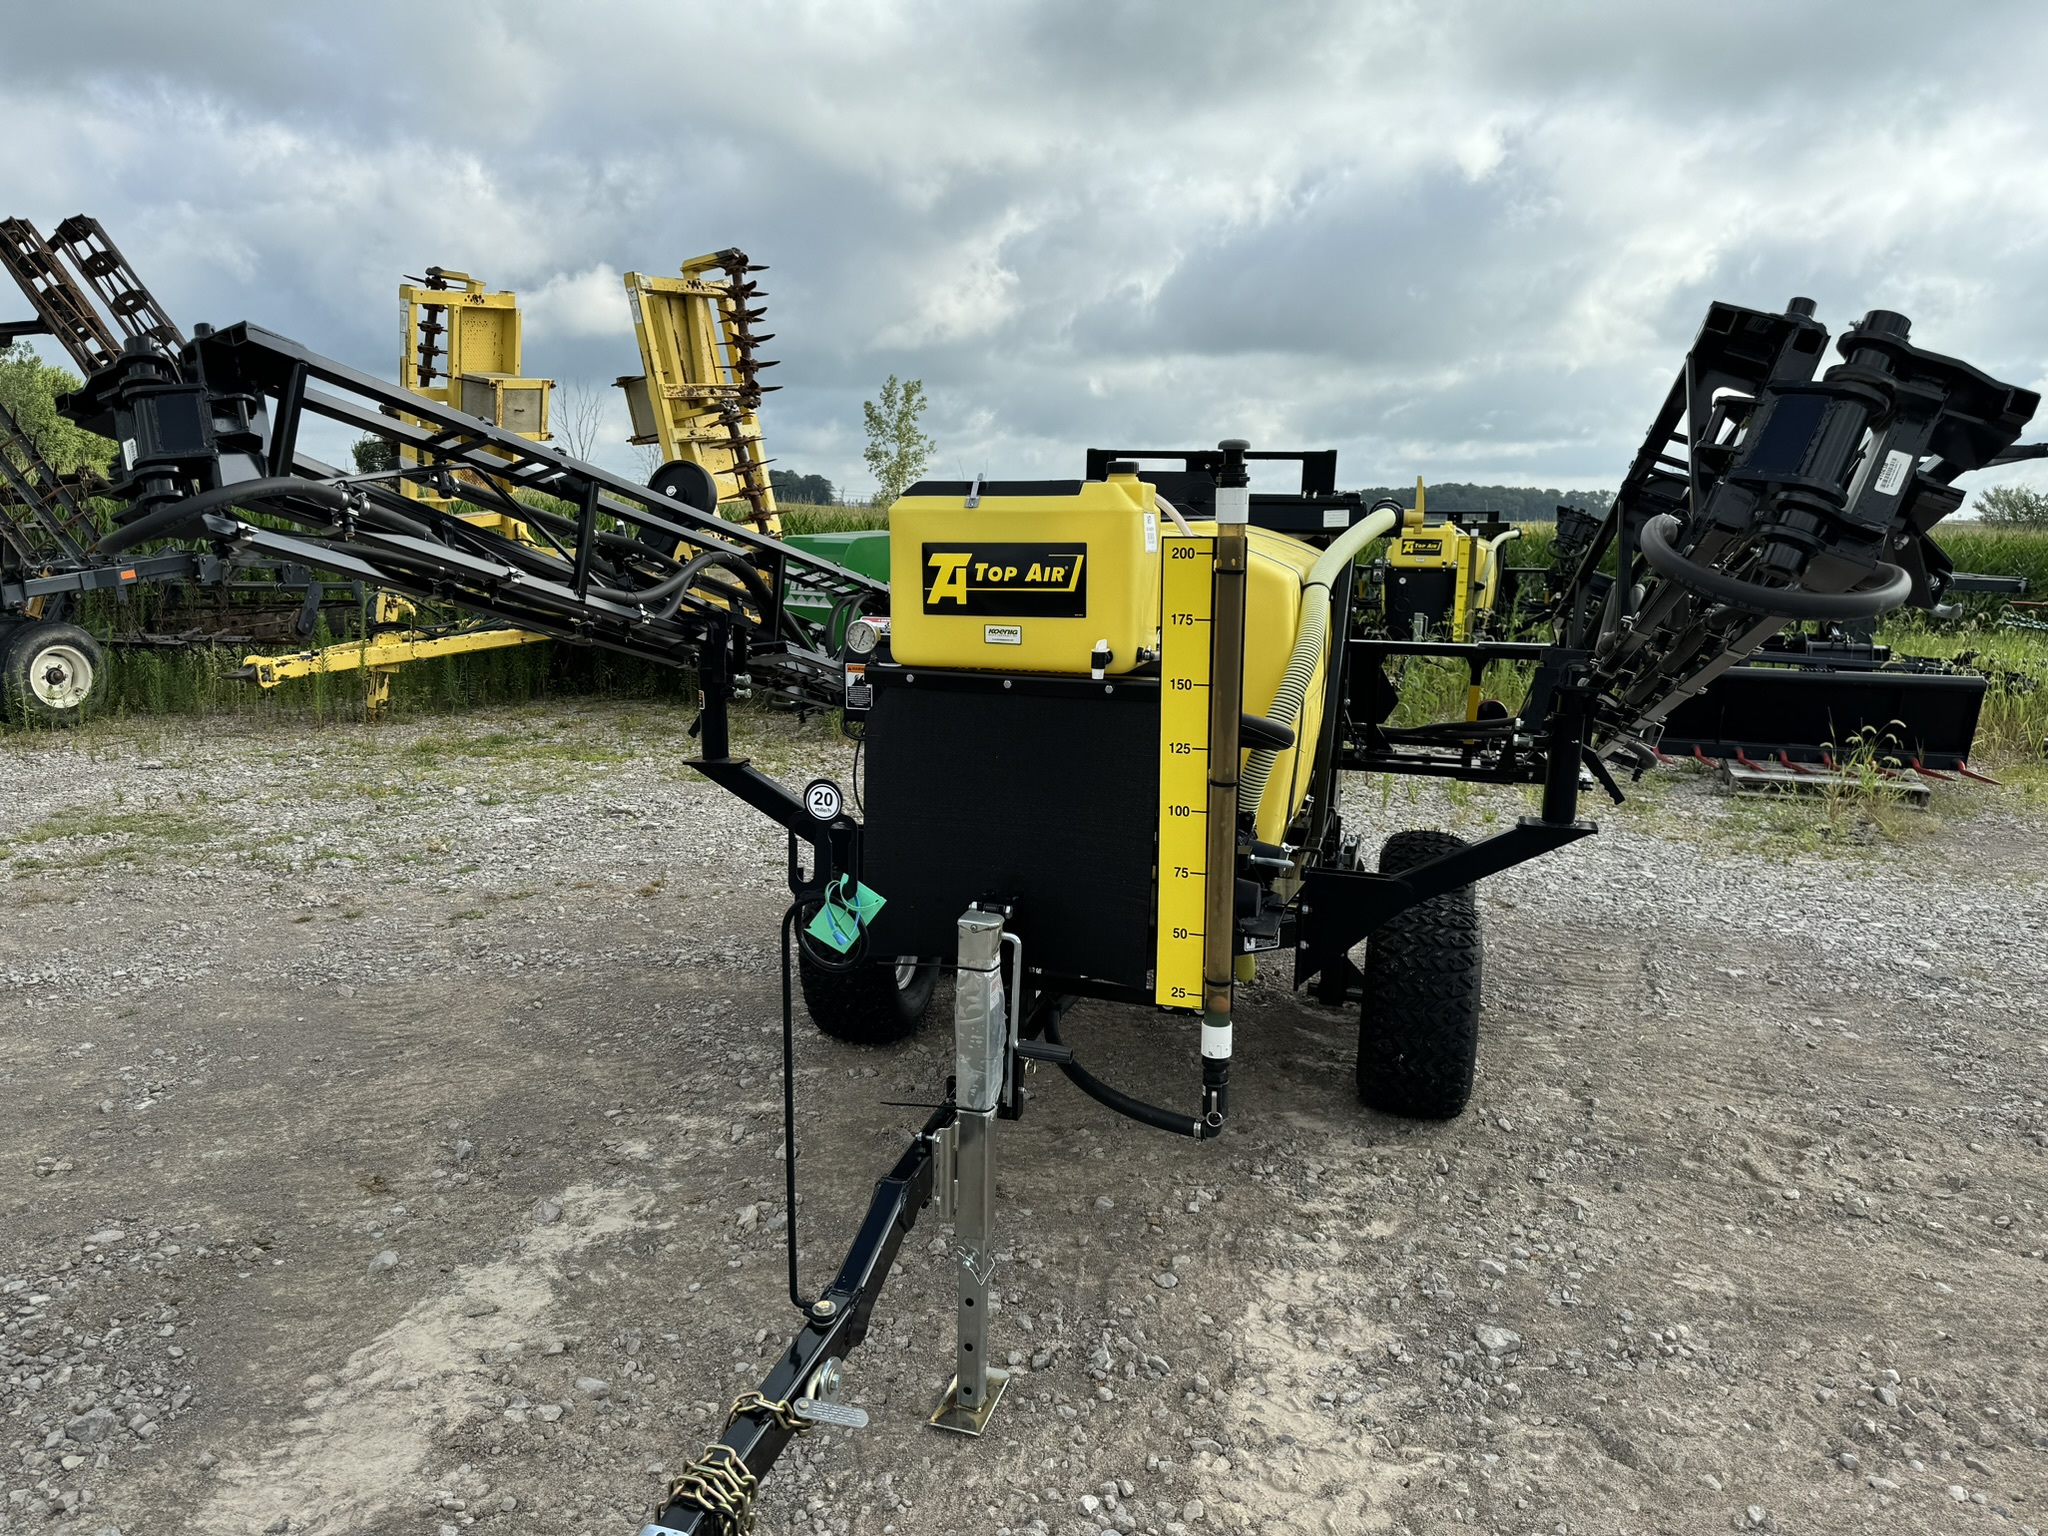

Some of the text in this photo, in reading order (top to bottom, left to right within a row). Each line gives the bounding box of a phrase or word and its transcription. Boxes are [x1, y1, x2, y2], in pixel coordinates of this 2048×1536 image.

[1172, 547, 1195, 559] 200
[975, 563, 1017, 582] TOP
[1171, 614, 1193, 625] 175
[1170, 678, 1192, 690] 150
[1169, 742, 1190, 754] 125
[814, 791, 833, 807] 20
[1168, 805, 1189, 817] 100
[1174, 867, 1189, 878] 75
[1173, 928, 1187, 939] 50
[1171, 987, 1186, 998] 25
